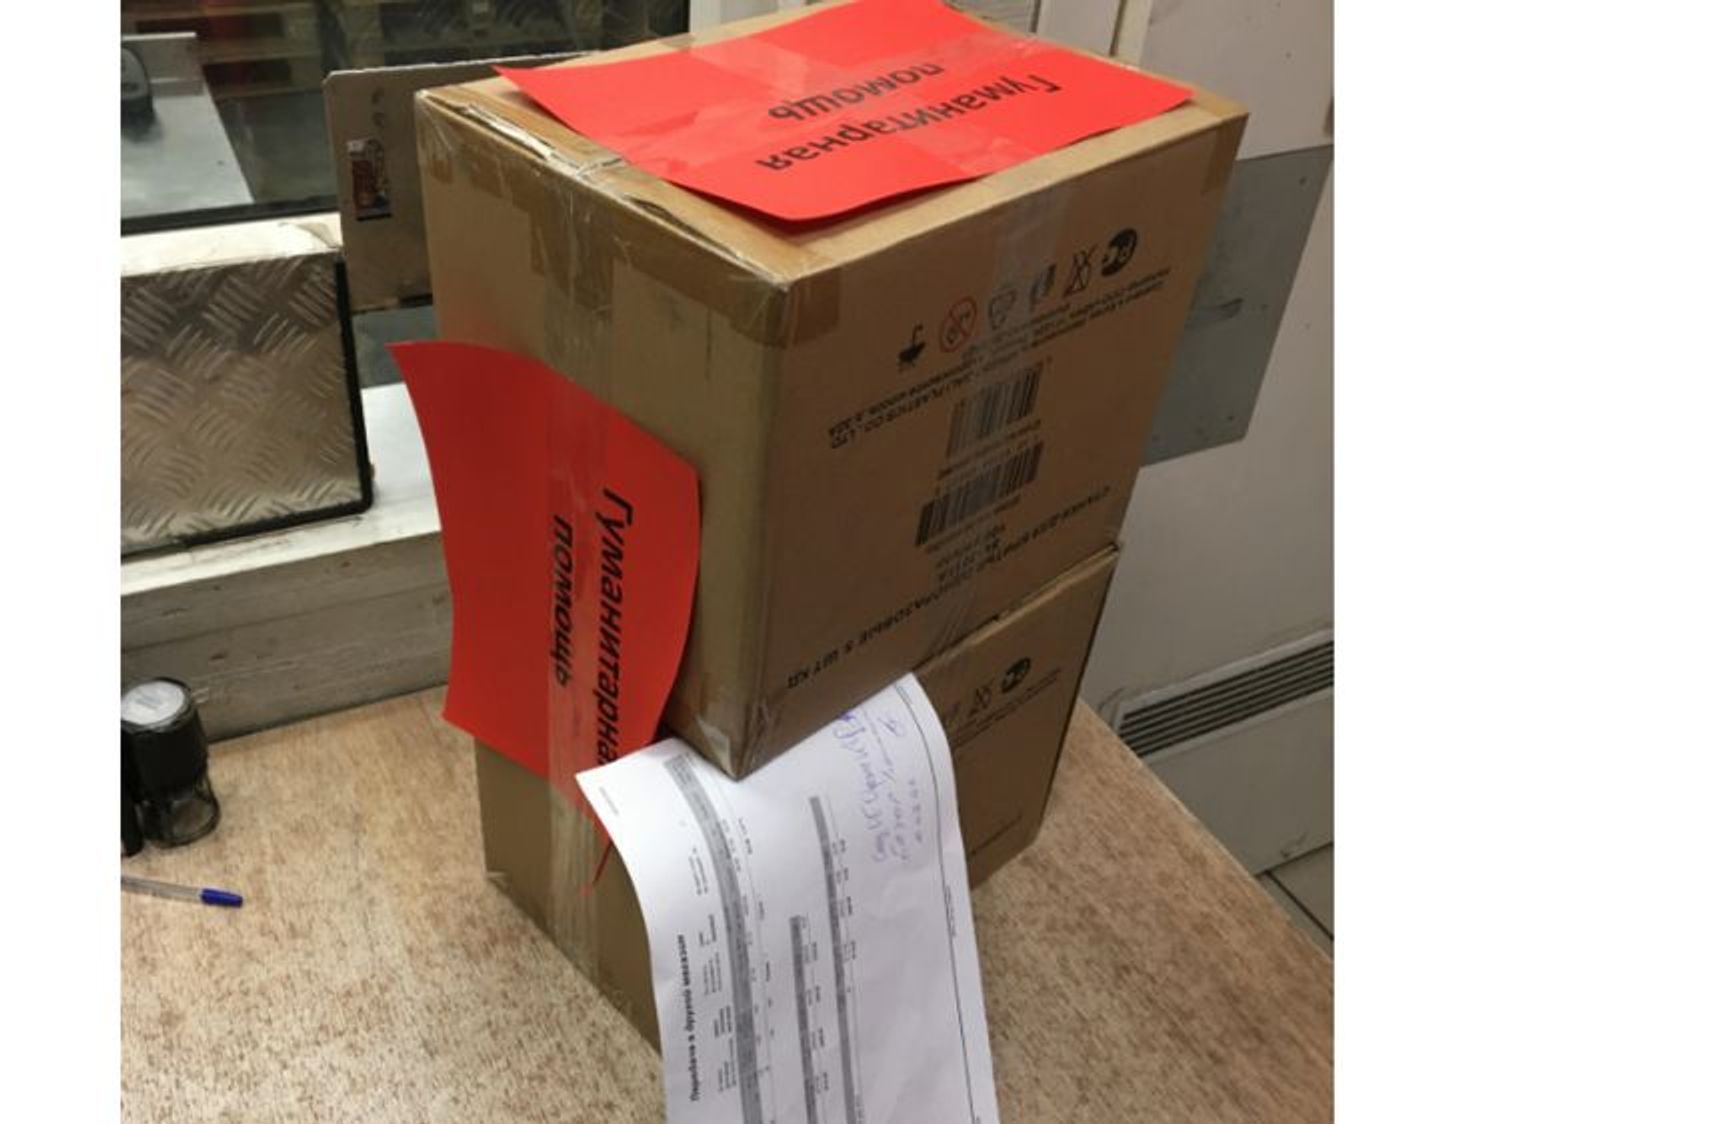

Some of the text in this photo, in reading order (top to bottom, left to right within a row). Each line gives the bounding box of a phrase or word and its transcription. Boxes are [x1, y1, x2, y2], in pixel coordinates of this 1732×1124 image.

[757, 74, 1062, 170] Гуманитарная
[767, 63, 945, 121] помощь
[550, 514, 573, 688] помощь
[593, 487, 634, 767] Гуманитарна
